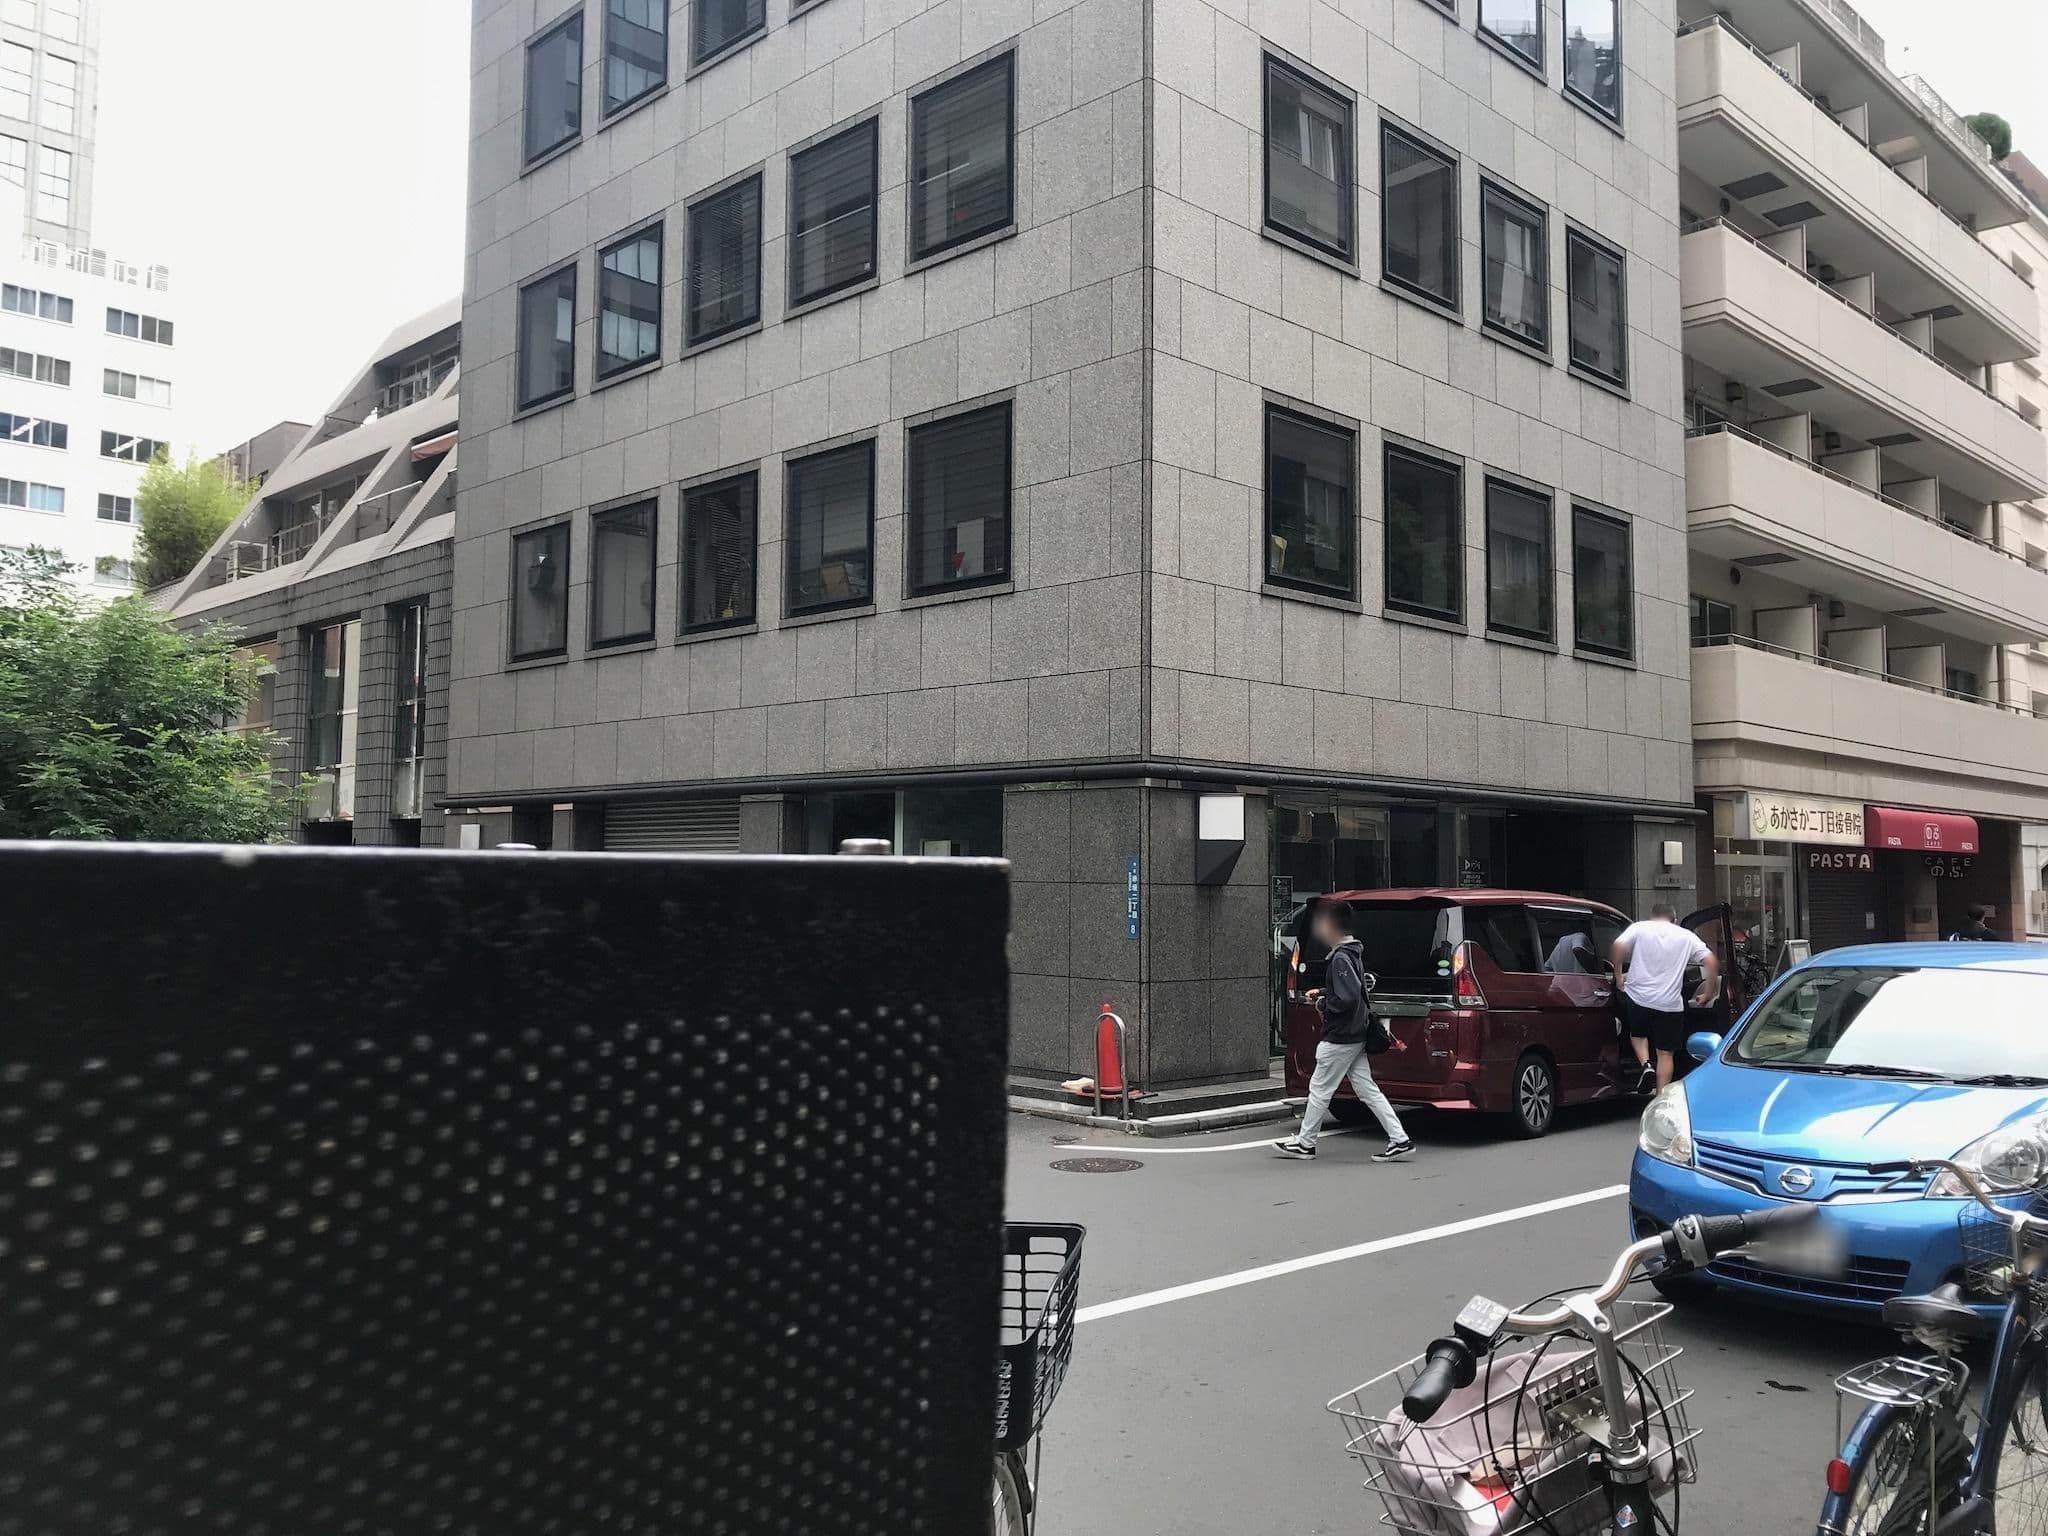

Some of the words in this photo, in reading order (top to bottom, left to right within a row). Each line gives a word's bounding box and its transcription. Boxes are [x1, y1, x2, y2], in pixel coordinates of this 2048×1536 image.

[1770, 805, 1862, 835] あかさか二丁目接骨院
[1810, 853, 1871, 869] PASTA
[1924, 856, 1972, 867] CAFE
